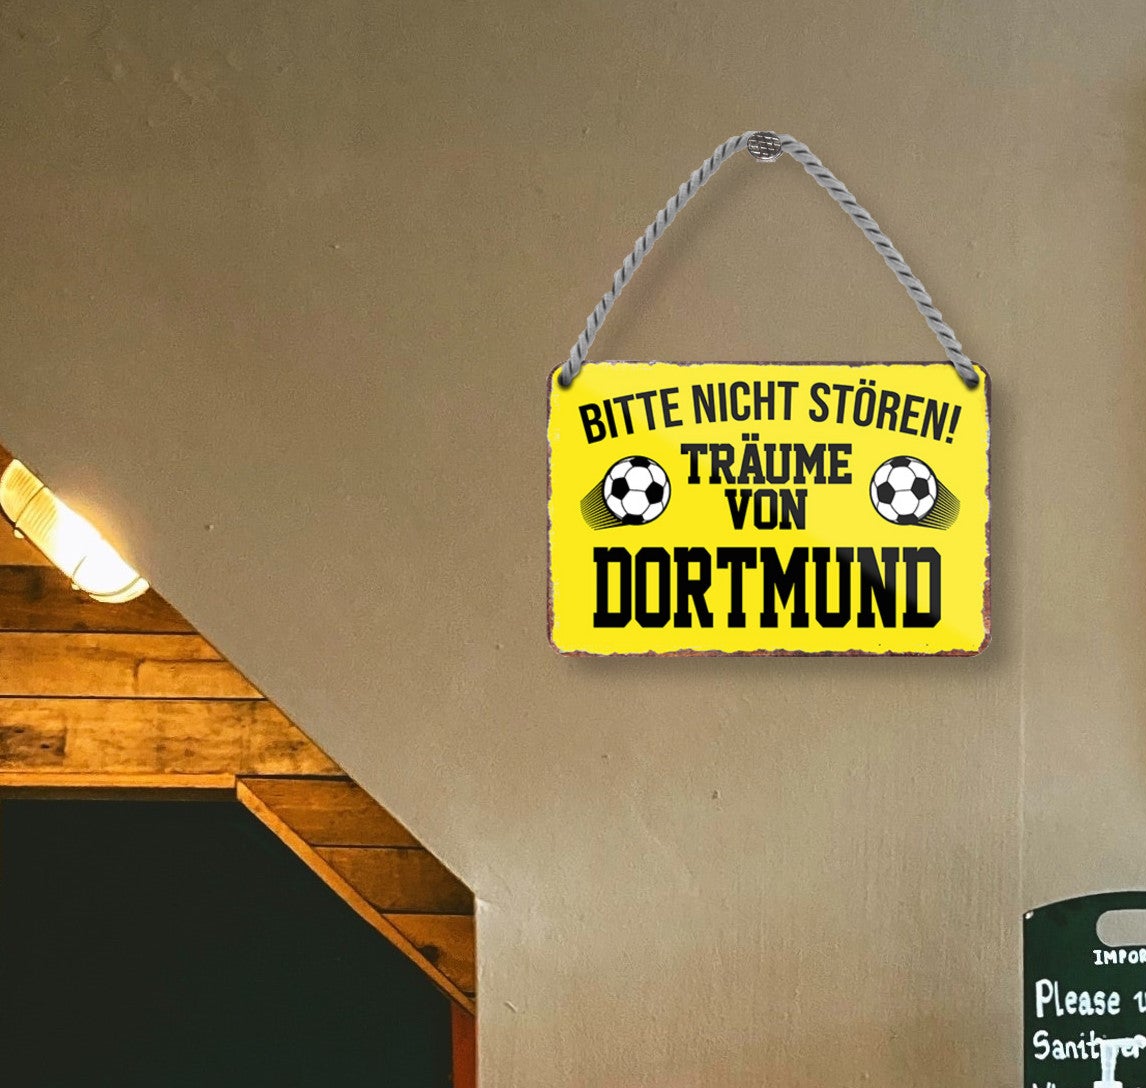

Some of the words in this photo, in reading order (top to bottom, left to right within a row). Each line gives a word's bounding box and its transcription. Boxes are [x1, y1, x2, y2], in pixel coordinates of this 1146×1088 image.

[579, 387, 683, 444] BITTE
[691, 380, 799, 424] NICHT
[808, 378, 962, 444] STÖREN!
[680, 433, 853, 484] TRÄUME
[724, 489, 808, 530] VON
[593, 547, 942, 629] DORTMUND
[1035, 978, 1121, 1018] Please
